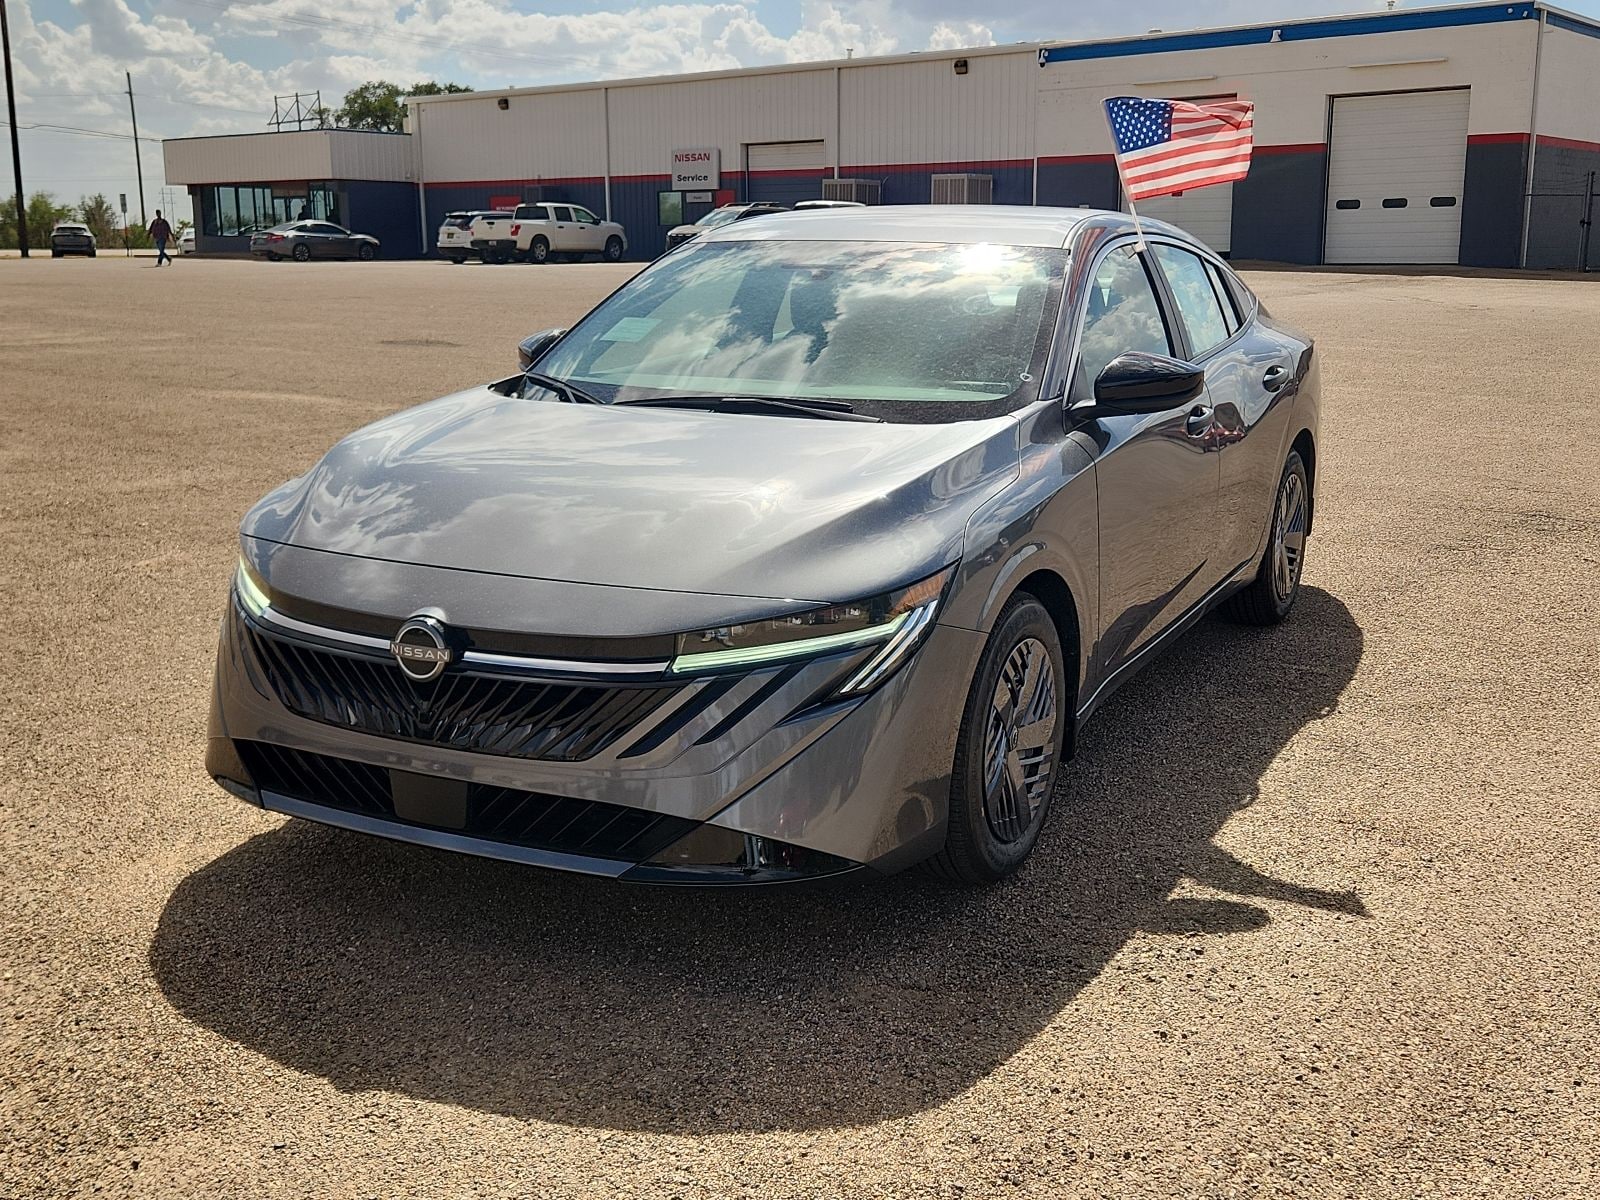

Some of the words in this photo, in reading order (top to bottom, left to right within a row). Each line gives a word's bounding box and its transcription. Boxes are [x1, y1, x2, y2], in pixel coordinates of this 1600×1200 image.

[674, 153, 711, 163] NISSAN
[677, 174, 709, 182] Service
[391, 643, 449, 660] NISSAN
